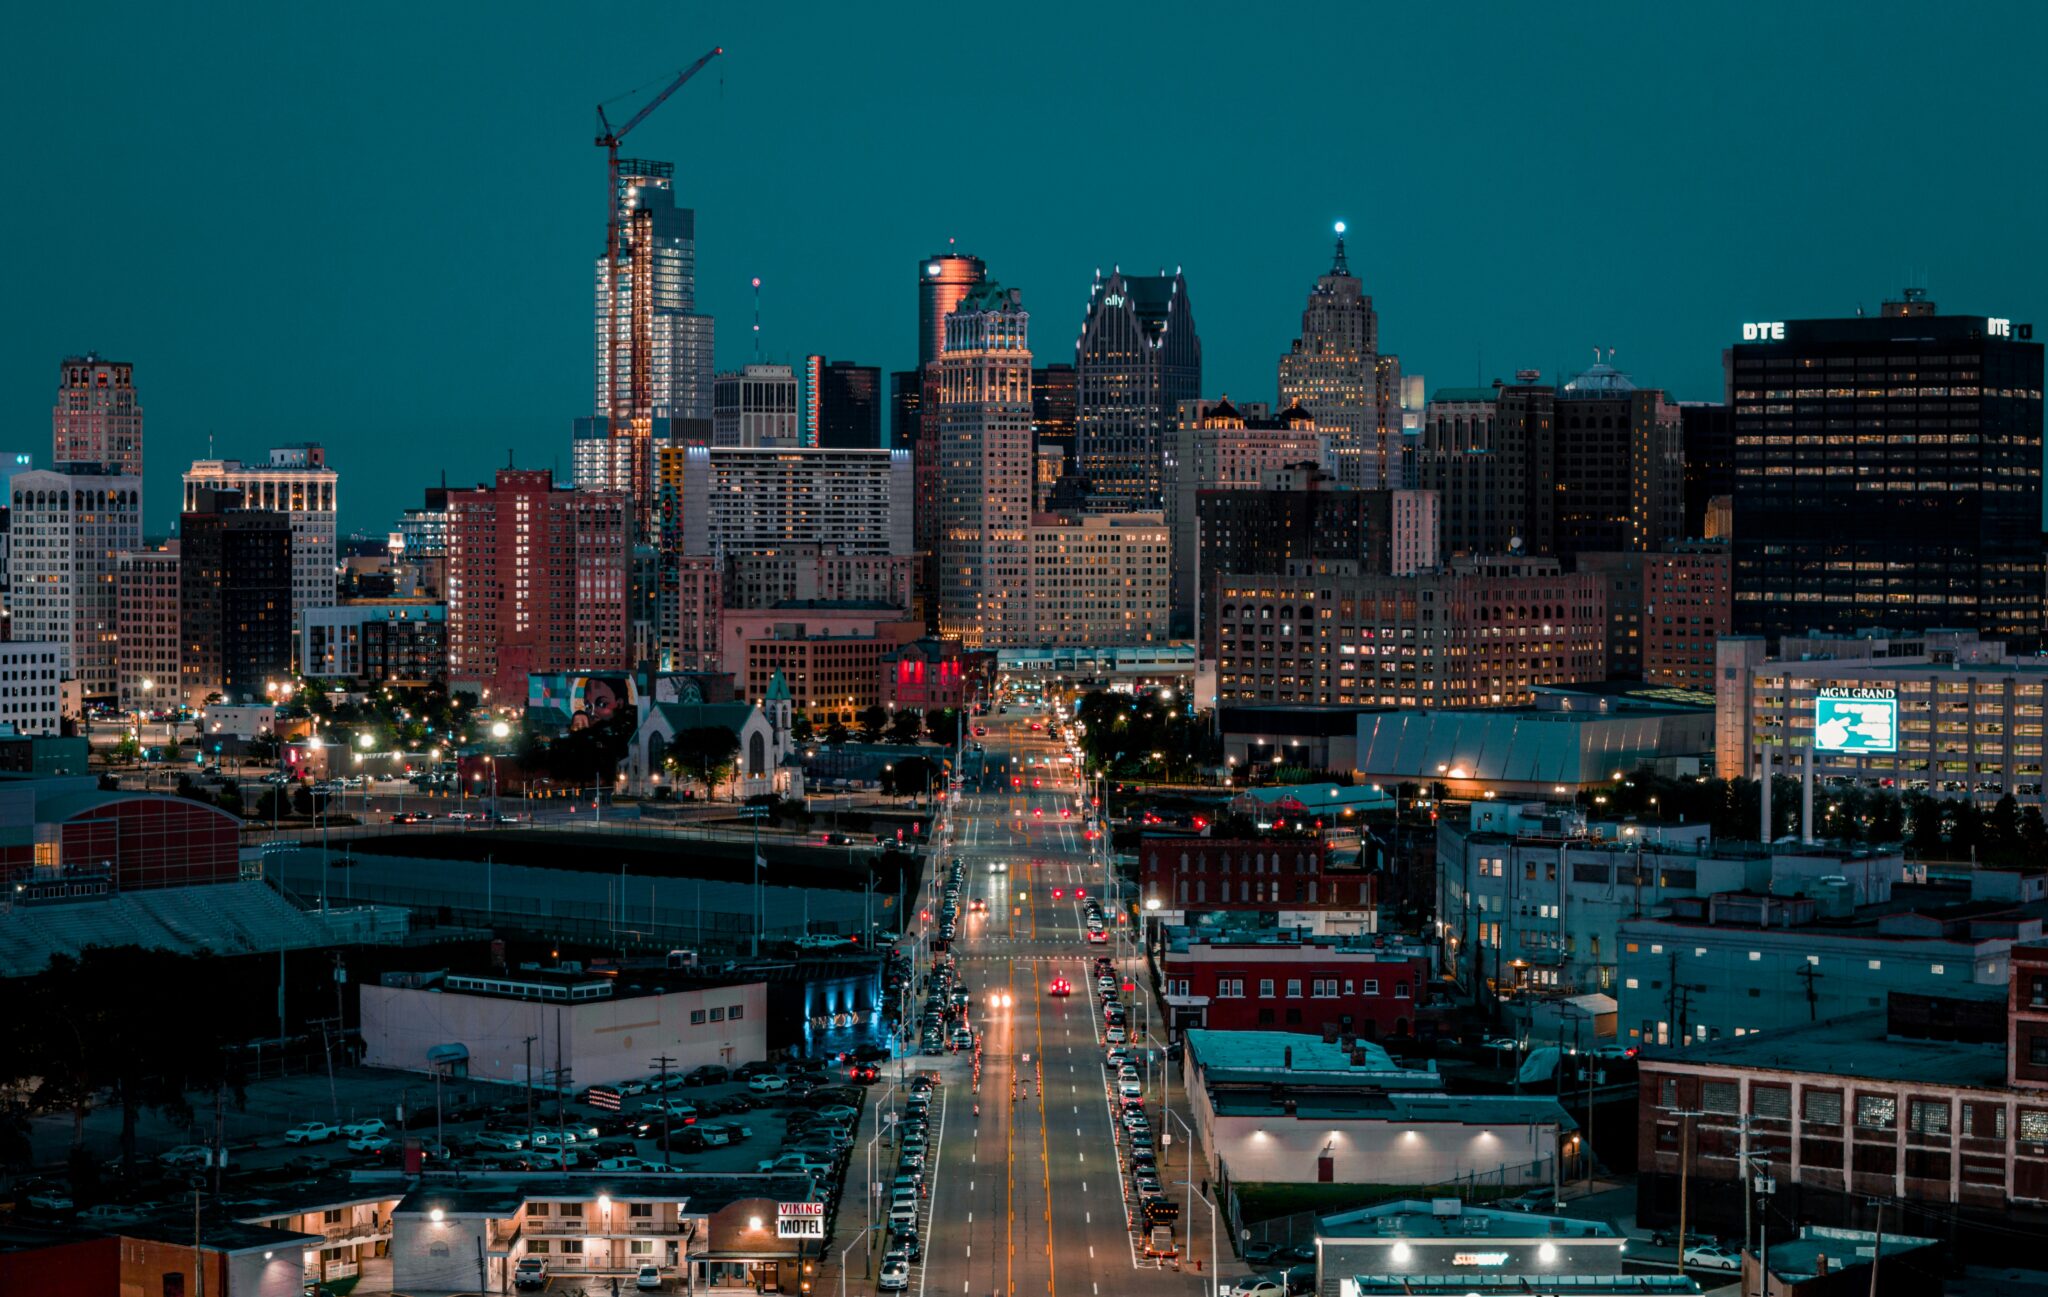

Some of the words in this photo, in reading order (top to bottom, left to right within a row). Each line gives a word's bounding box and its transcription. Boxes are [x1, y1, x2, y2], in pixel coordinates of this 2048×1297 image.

[1105, 294, 1124, 308] ally
[1743, 322, 1785, 340] DTE
[1988, 317, 2010, 336] DTE
[1820, 687, 1849, 698] MGM
[1852, 688, 1895, 699] GRAND
[780, 1203, 822, 1215] VIKING
[780, 1220, 821, 1234] MOTEL
